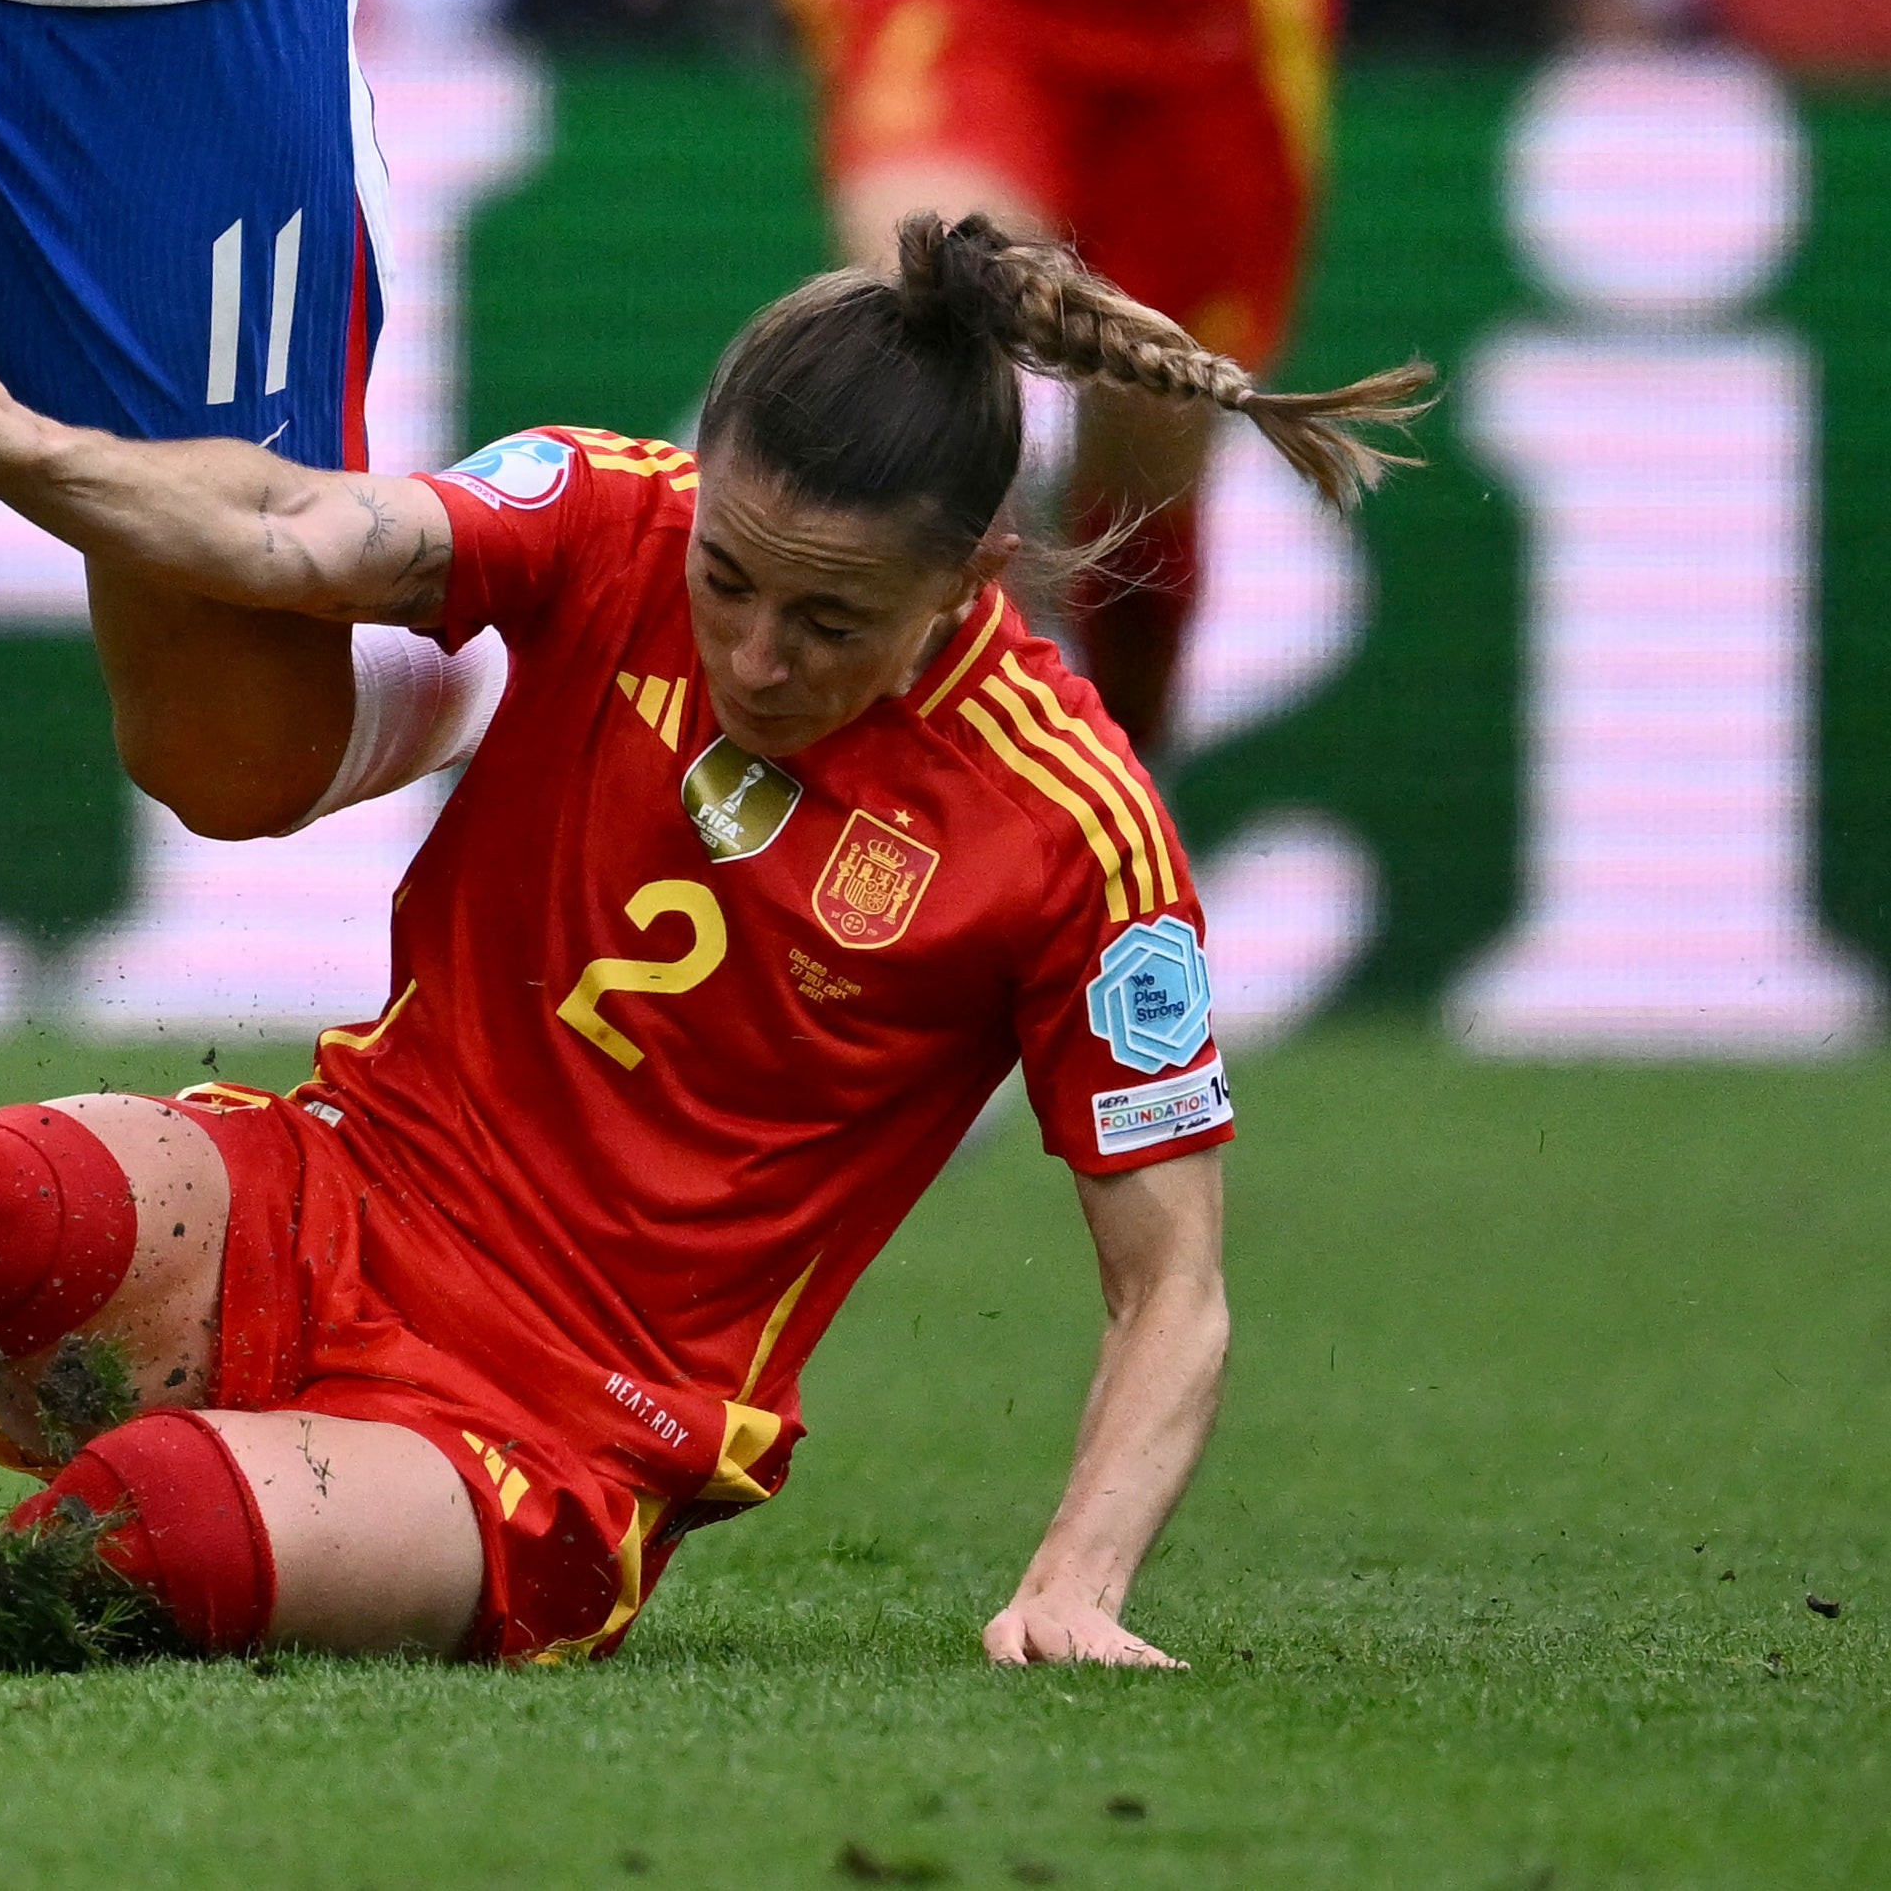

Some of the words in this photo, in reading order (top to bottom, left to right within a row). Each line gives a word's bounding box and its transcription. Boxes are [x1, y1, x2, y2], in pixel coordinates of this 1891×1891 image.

[206, 207, 303, 405] 11
[698, 803, 739, 839] FIFA
[556, 879, 727, 1071] 2
[1131, 971, 1155, 987] We
[1137, 1000, 1185, 1022] Strong
[1098, 1094, 1130, 1109] UEFA
[1100, 1092, 1210, 1131] FOUNDATION
[605, 1372, 689, 1448] HEAT.RDY
